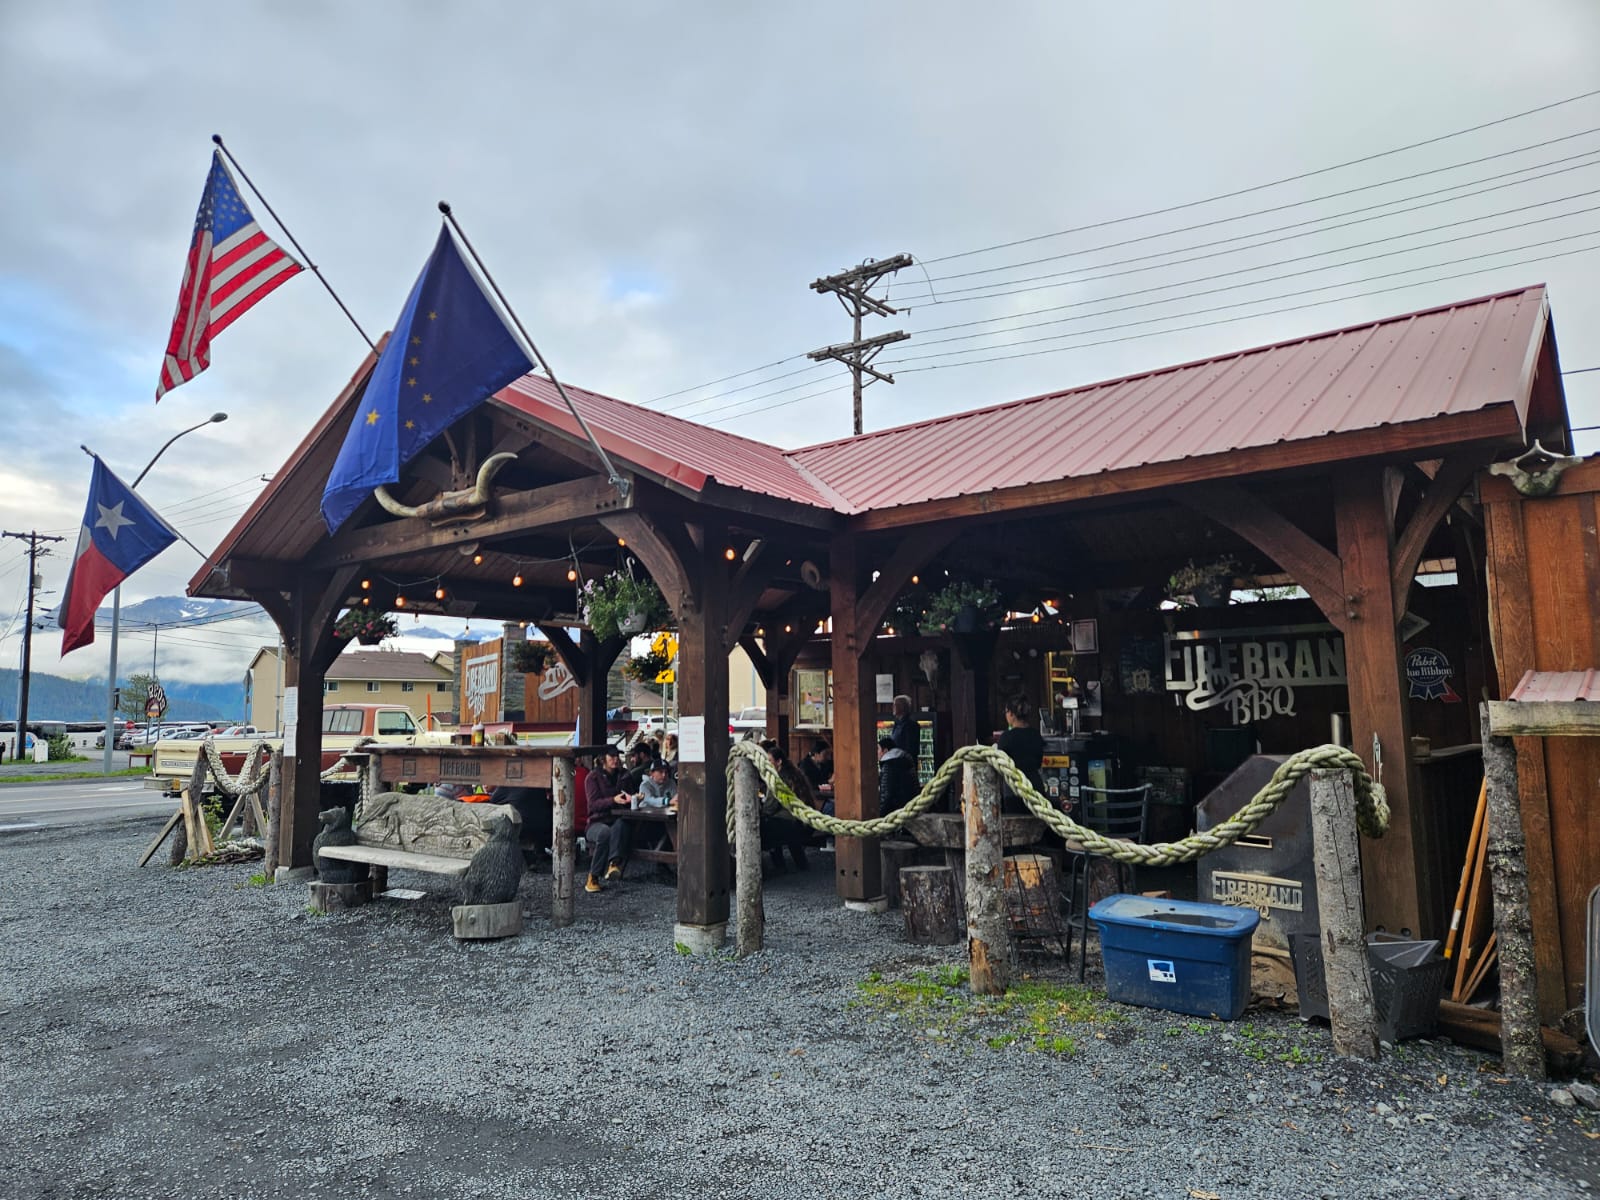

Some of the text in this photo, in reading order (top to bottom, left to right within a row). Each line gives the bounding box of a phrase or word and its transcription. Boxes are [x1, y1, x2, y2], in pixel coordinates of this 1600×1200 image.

[1164, 625, 1346, 690] FIREBRAN
[1406, 666, 1453, 677] lue Ribbon
[1410, 654, 1438, 667] Pabst
[1224, 685, 1296, 725] BBQ
[1212, 870, 1303, 912] FIREBRAND
